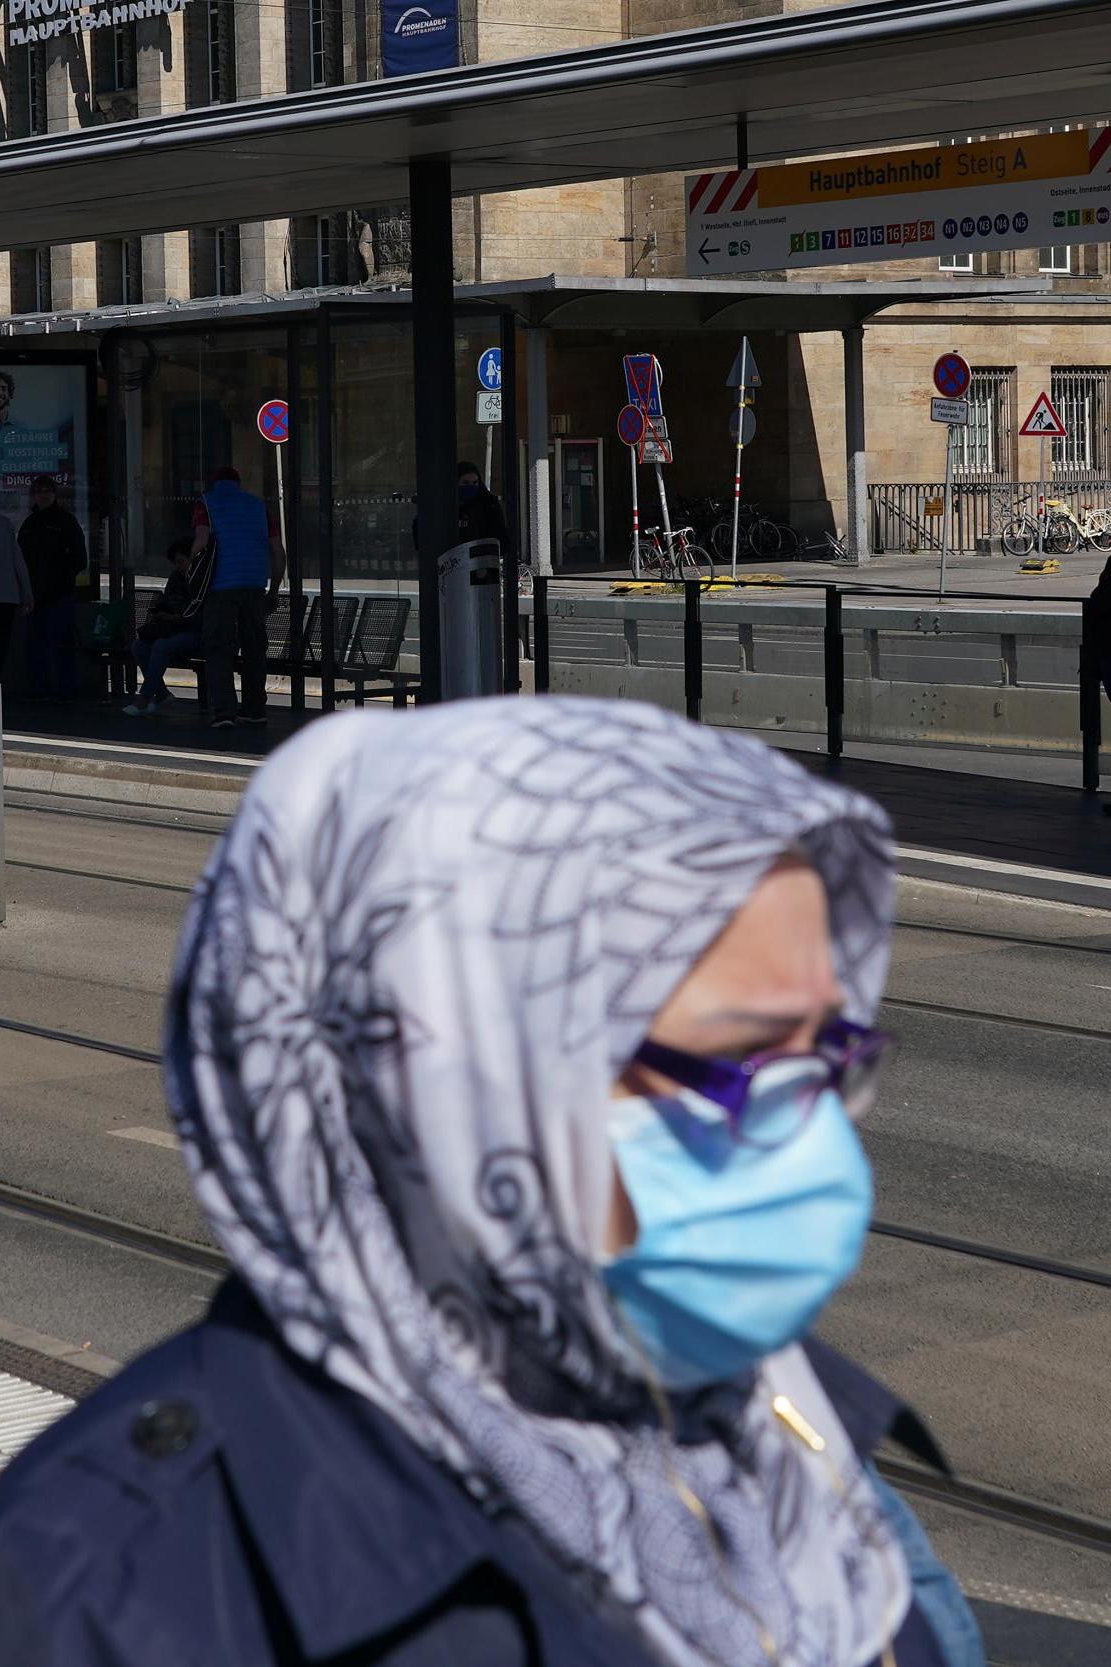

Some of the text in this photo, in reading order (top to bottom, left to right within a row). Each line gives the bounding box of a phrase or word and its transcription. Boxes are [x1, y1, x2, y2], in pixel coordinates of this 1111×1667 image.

[401, 17, 447, 32] PROMENADEN
[809, 147, 1028, 194] Hauptbahnhof Steig A
[855, 229, 867, 244] 12
[871, 229, 883, 243] 15
[888, 227, 900, 241] 16
